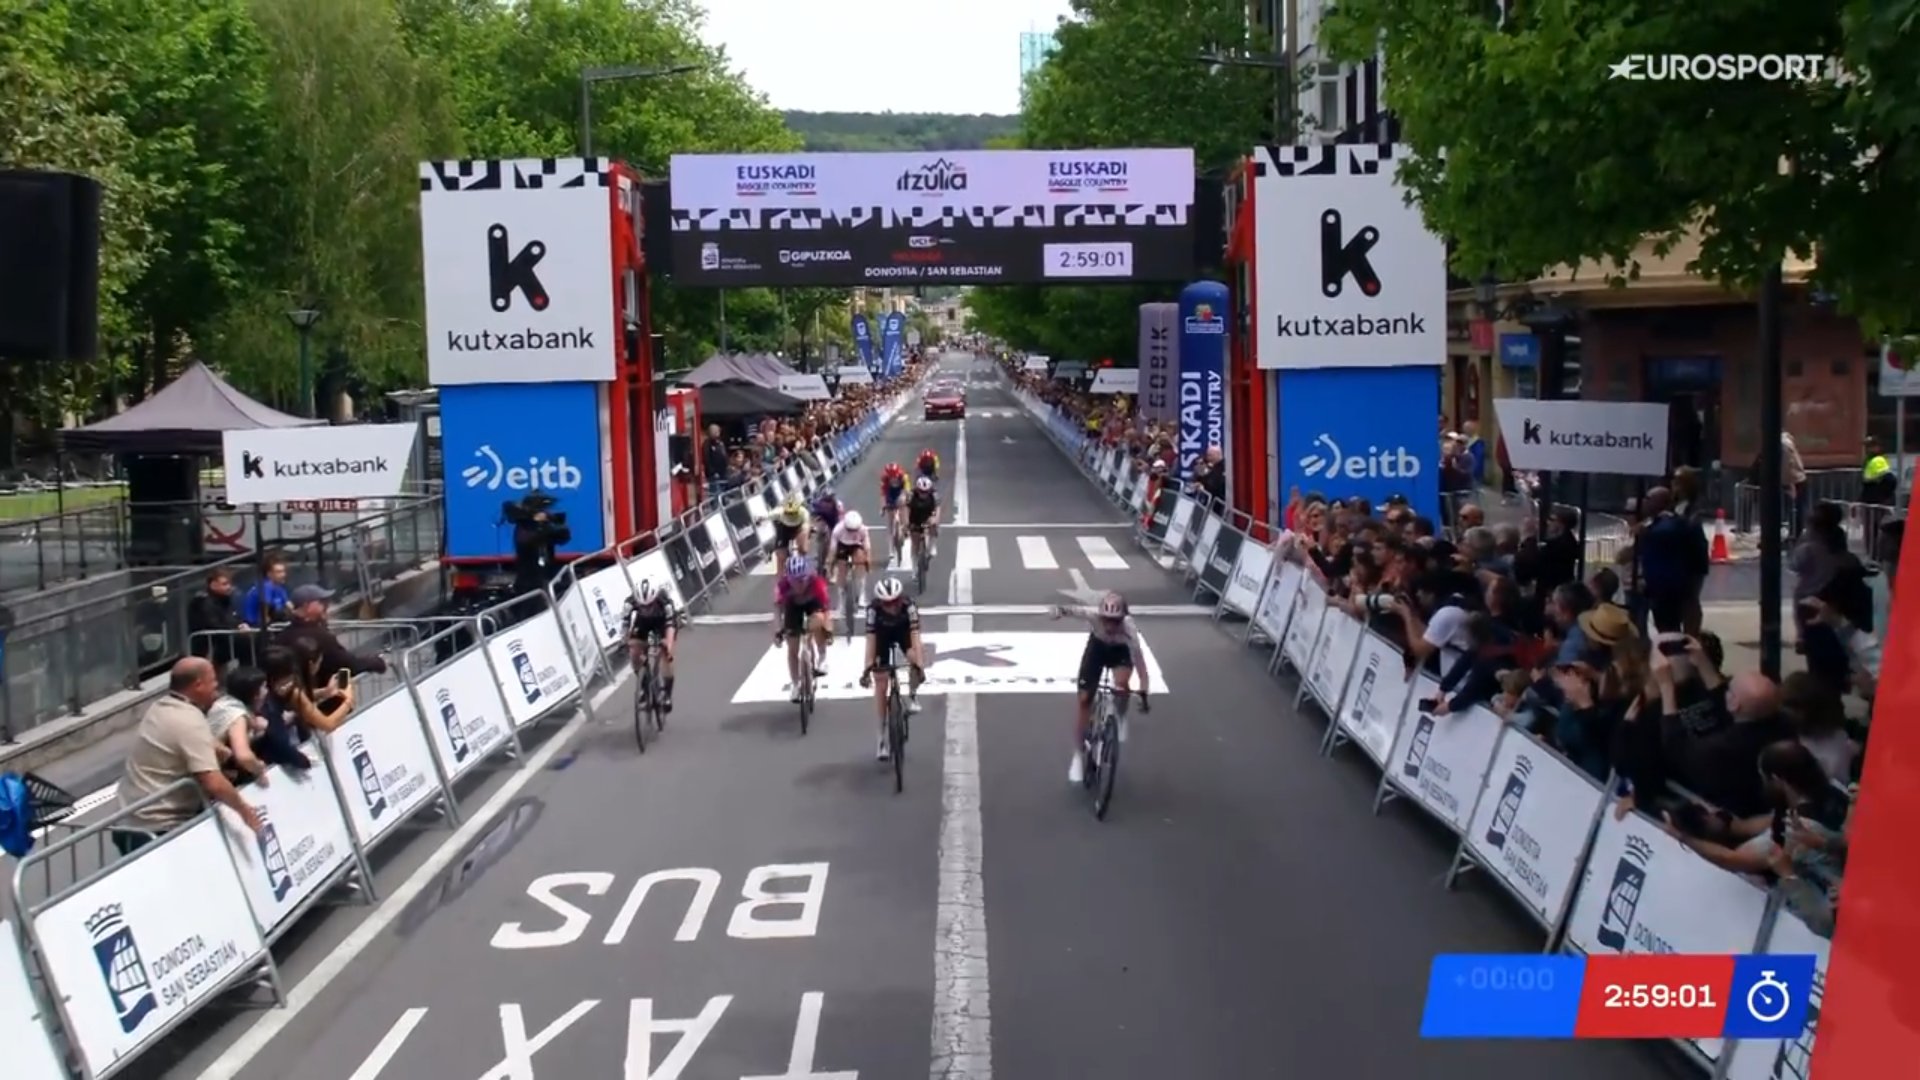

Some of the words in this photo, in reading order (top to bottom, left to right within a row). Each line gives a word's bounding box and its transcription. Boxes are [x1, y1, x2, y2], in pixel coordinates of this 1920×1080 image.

[737, 165, 816, 180] EUSKADI
[1049, 162, 1128, 176] EUSKADI
[771, 182, 816, 190] COUNTRY
[1084, 178, 1128, 187] COUNTRY
[791, 251, 851, 262] GIPUZKOA
[1060, 251, 1125, 268] 2:59:01
[865, 267, 918, 277] DONOSTIA
[927, 267, 947, 276] SAN
[1277, 313, 1426, 337] kutxabank
[448, 328, 594, 351] kutxabank
[1149, 326, 1168, 408] GOBIK
[1181, 372, 1202, 478] SKADI
[1550, 430, 1653, 450] kutxabank
[274, 456, 388, 477] kutxabank
[506, 457, 582, 490] eitb
[1345, 447, 1420, 479] eitb
[490, 862, 830, 949] BUS
[152, 934, 206, 980] DONOSTIA
[162, 978, 186, 1006] SAN
[348, 991, 859, 1080] TAXI
